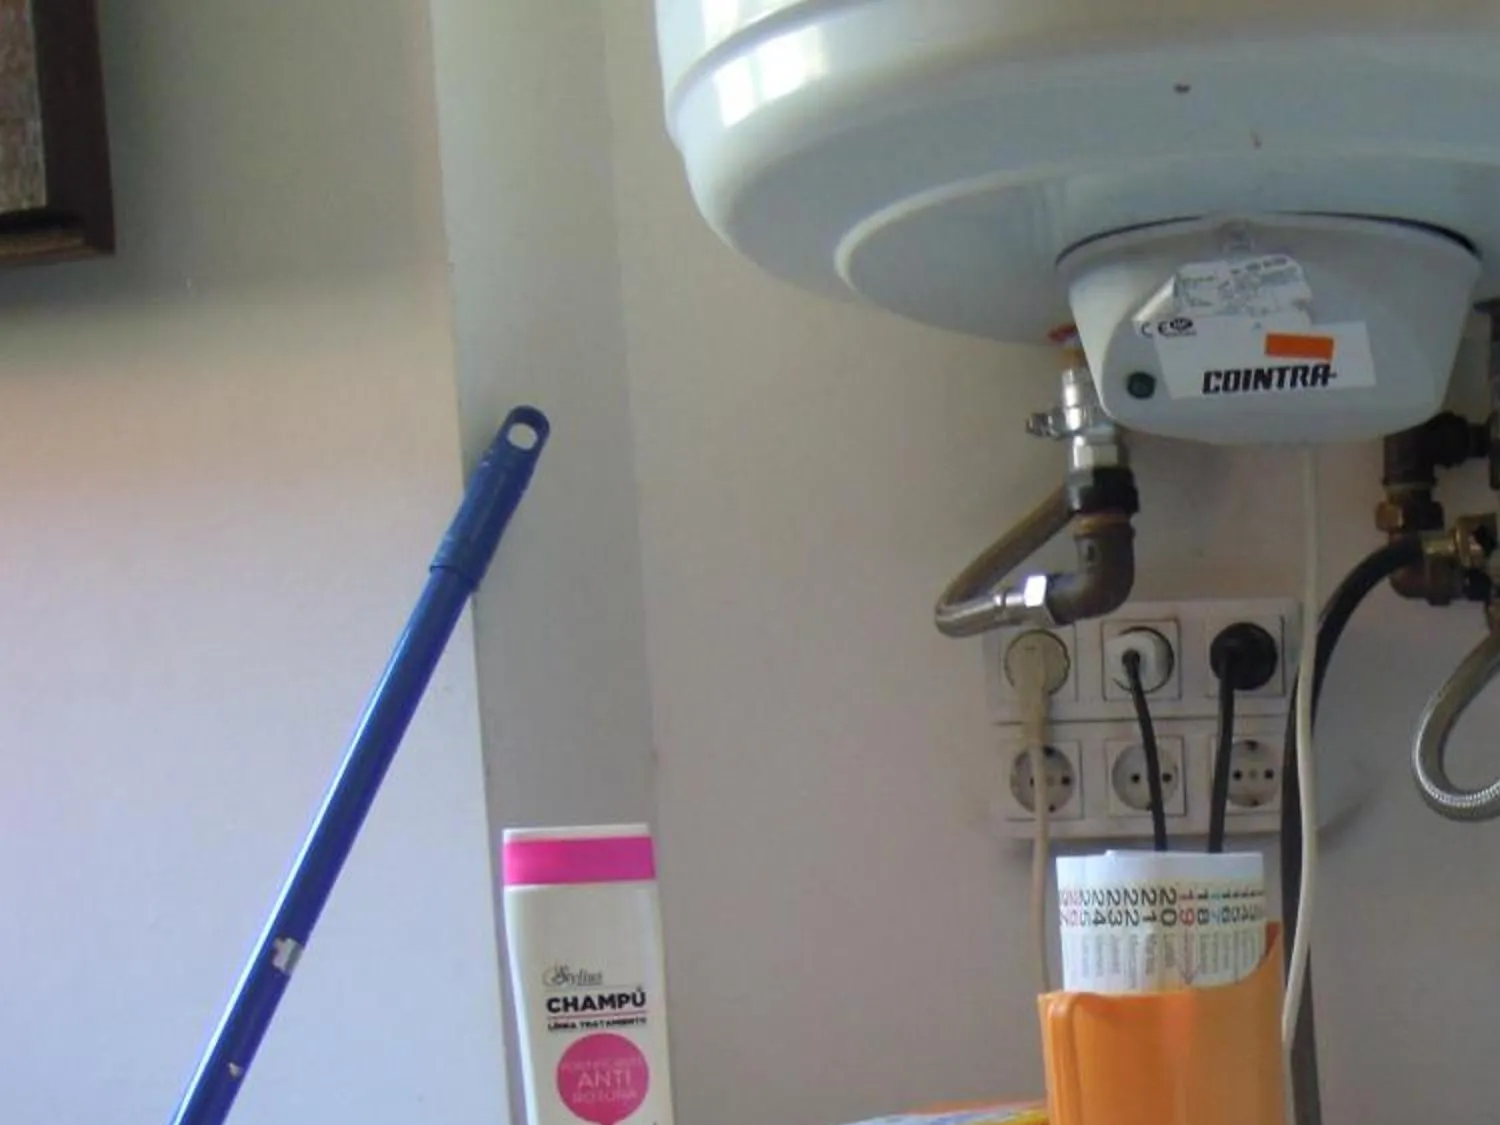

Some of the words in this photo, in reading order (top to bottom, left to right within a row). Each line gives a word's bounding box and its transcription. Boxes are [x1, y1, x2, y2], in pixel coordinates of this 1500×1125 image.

[1202, 363, 1337, 396] COINTRA
[1092, 887, 1107, 927] 24
[1106, 887, 1123, 927] 23
[1122, 887, 1140, 927] 22
[1140, 886, 1158, 923] 21
[1160, 887, 1178, 927] 20
[1180, 890, 1195, 927] 19
[1198, 889, 1209, 925] 18
[546, 984, 646, 1013] CHAMPÚ
[578, 1069, 632, 1088] ANTI
